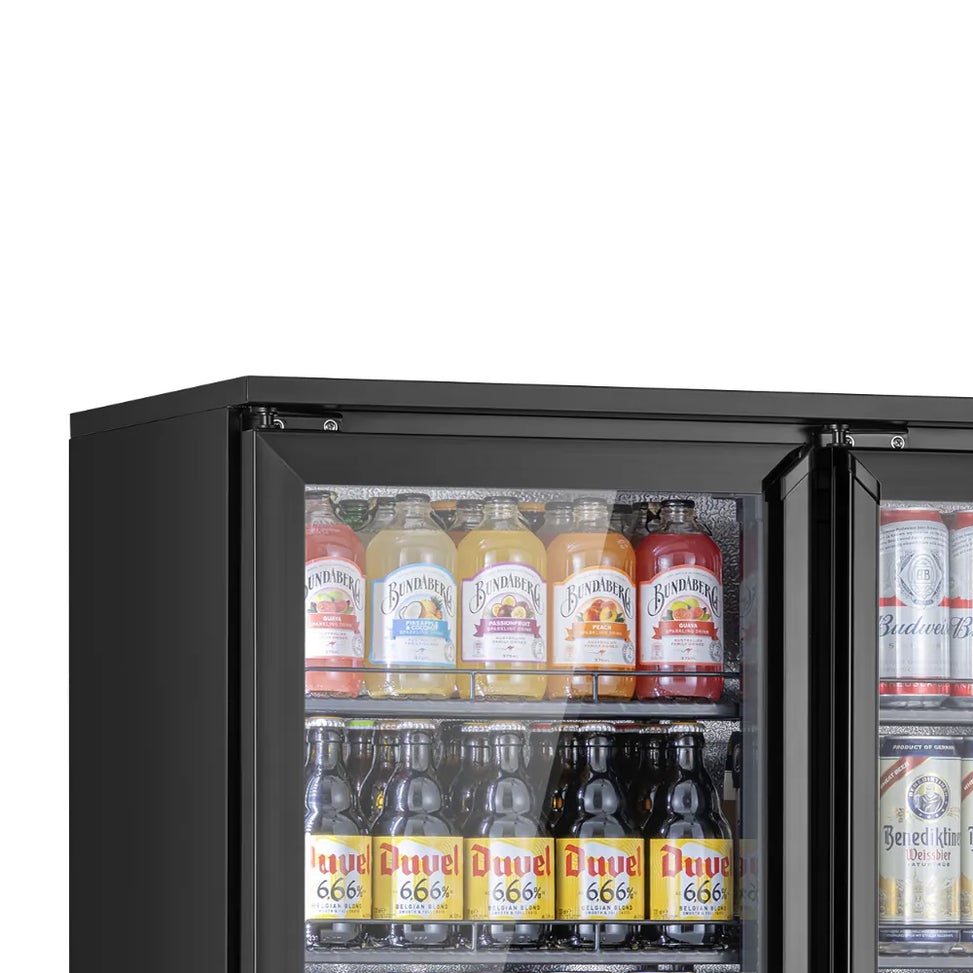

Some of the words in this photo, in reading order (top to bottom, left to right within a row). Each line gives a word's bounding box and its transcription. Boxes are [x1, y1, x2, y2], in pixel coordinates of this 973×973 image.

[305, 567, 364, 611] UNDABERG
[381, 575, 455, 617] BUNDABERG
[469, 573, 543, 615] BUNDABERG
[560, 576, 633, 619] BUNDABERG
[647, 576, 720, 617] BUNDABERG
[380, 842, 459, 877] Duvel
[471, 844, 551, 878] Duvel
[564, 843, 641, 878] Duvel
[906, 848, 951, 862] Weissbier
